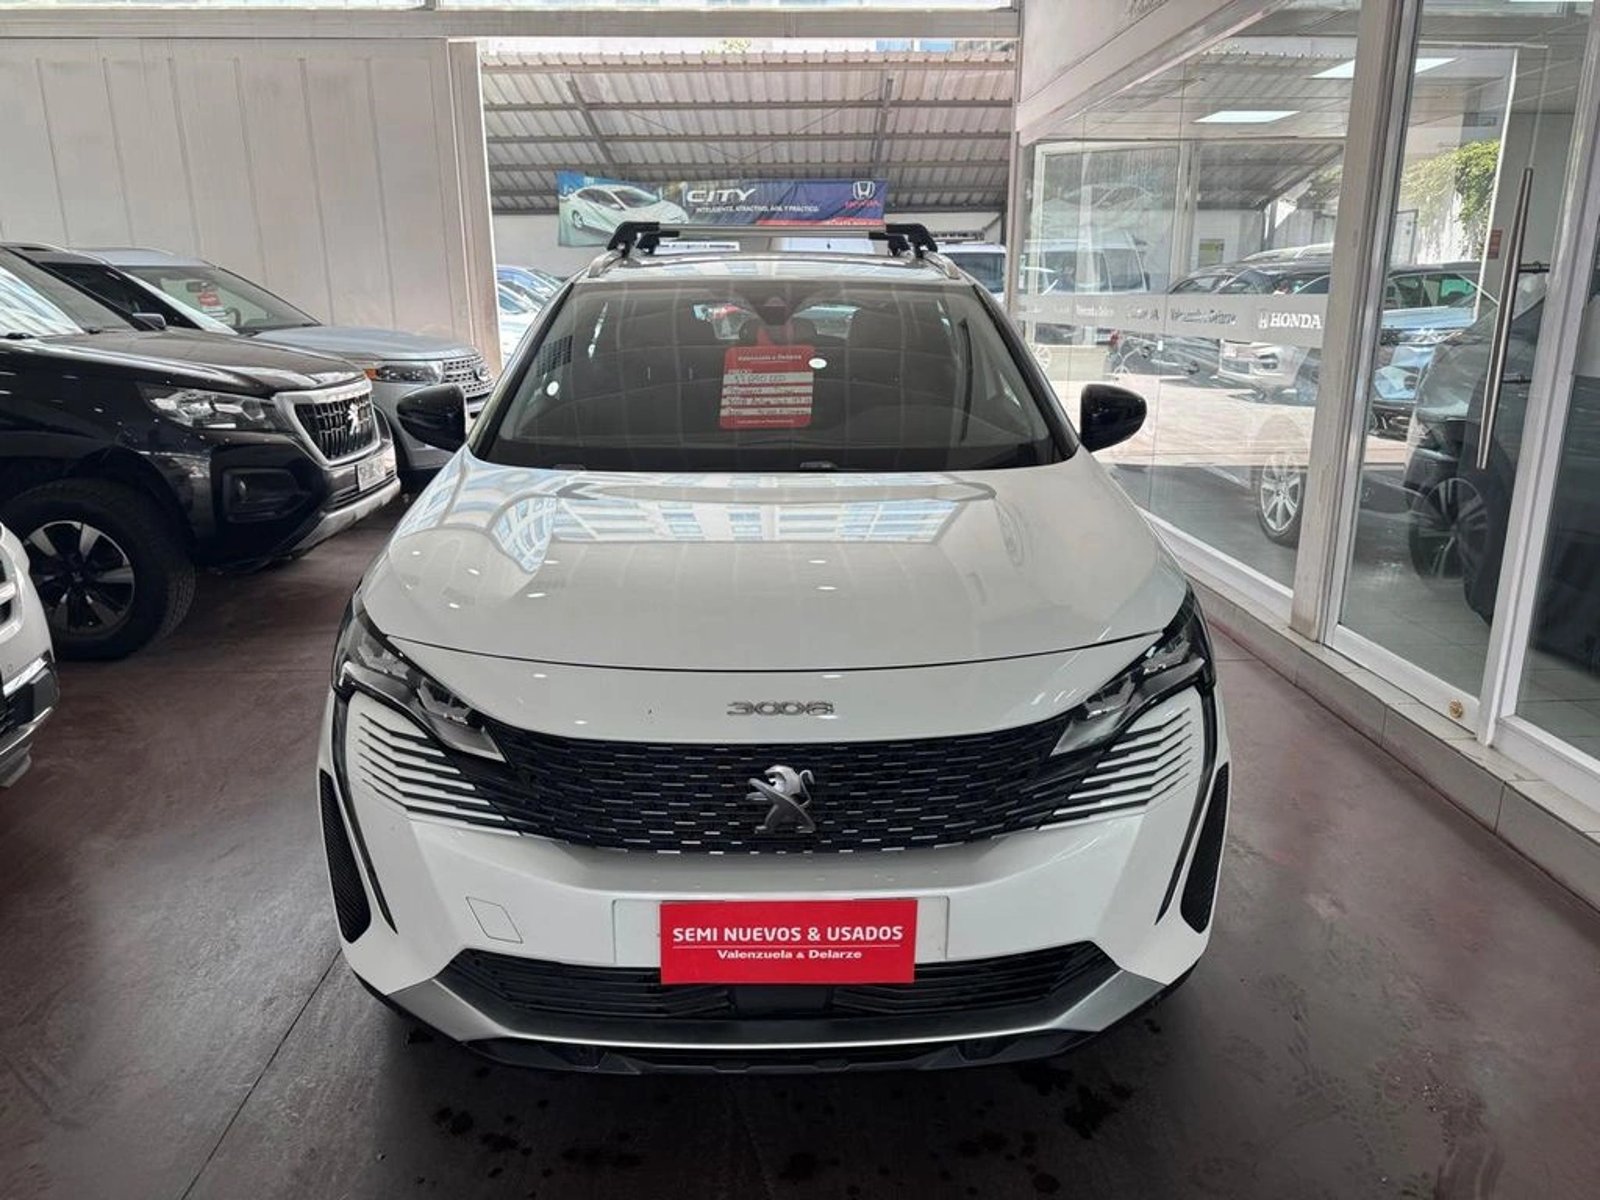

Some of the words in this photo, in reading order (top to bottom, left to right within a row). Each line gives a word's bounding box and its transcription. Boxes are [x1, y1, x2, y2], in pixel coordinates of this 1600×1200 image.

[687, 188, 757, 203] CITY
[1269, 312, 1322, 329] HONDA
[726, 700, 835, 716] 3008
[672, 927, 718, 942] SEMI
[724, 927, 802, 942] NUEVOS
[807, 927, 821, 942] &
[826, 926, 904, 941] USADOS
[717, 949, 793, 959] Valenzuela
[796, 951, 805, 959] &
[808, 949, 863, 960] Delarze
